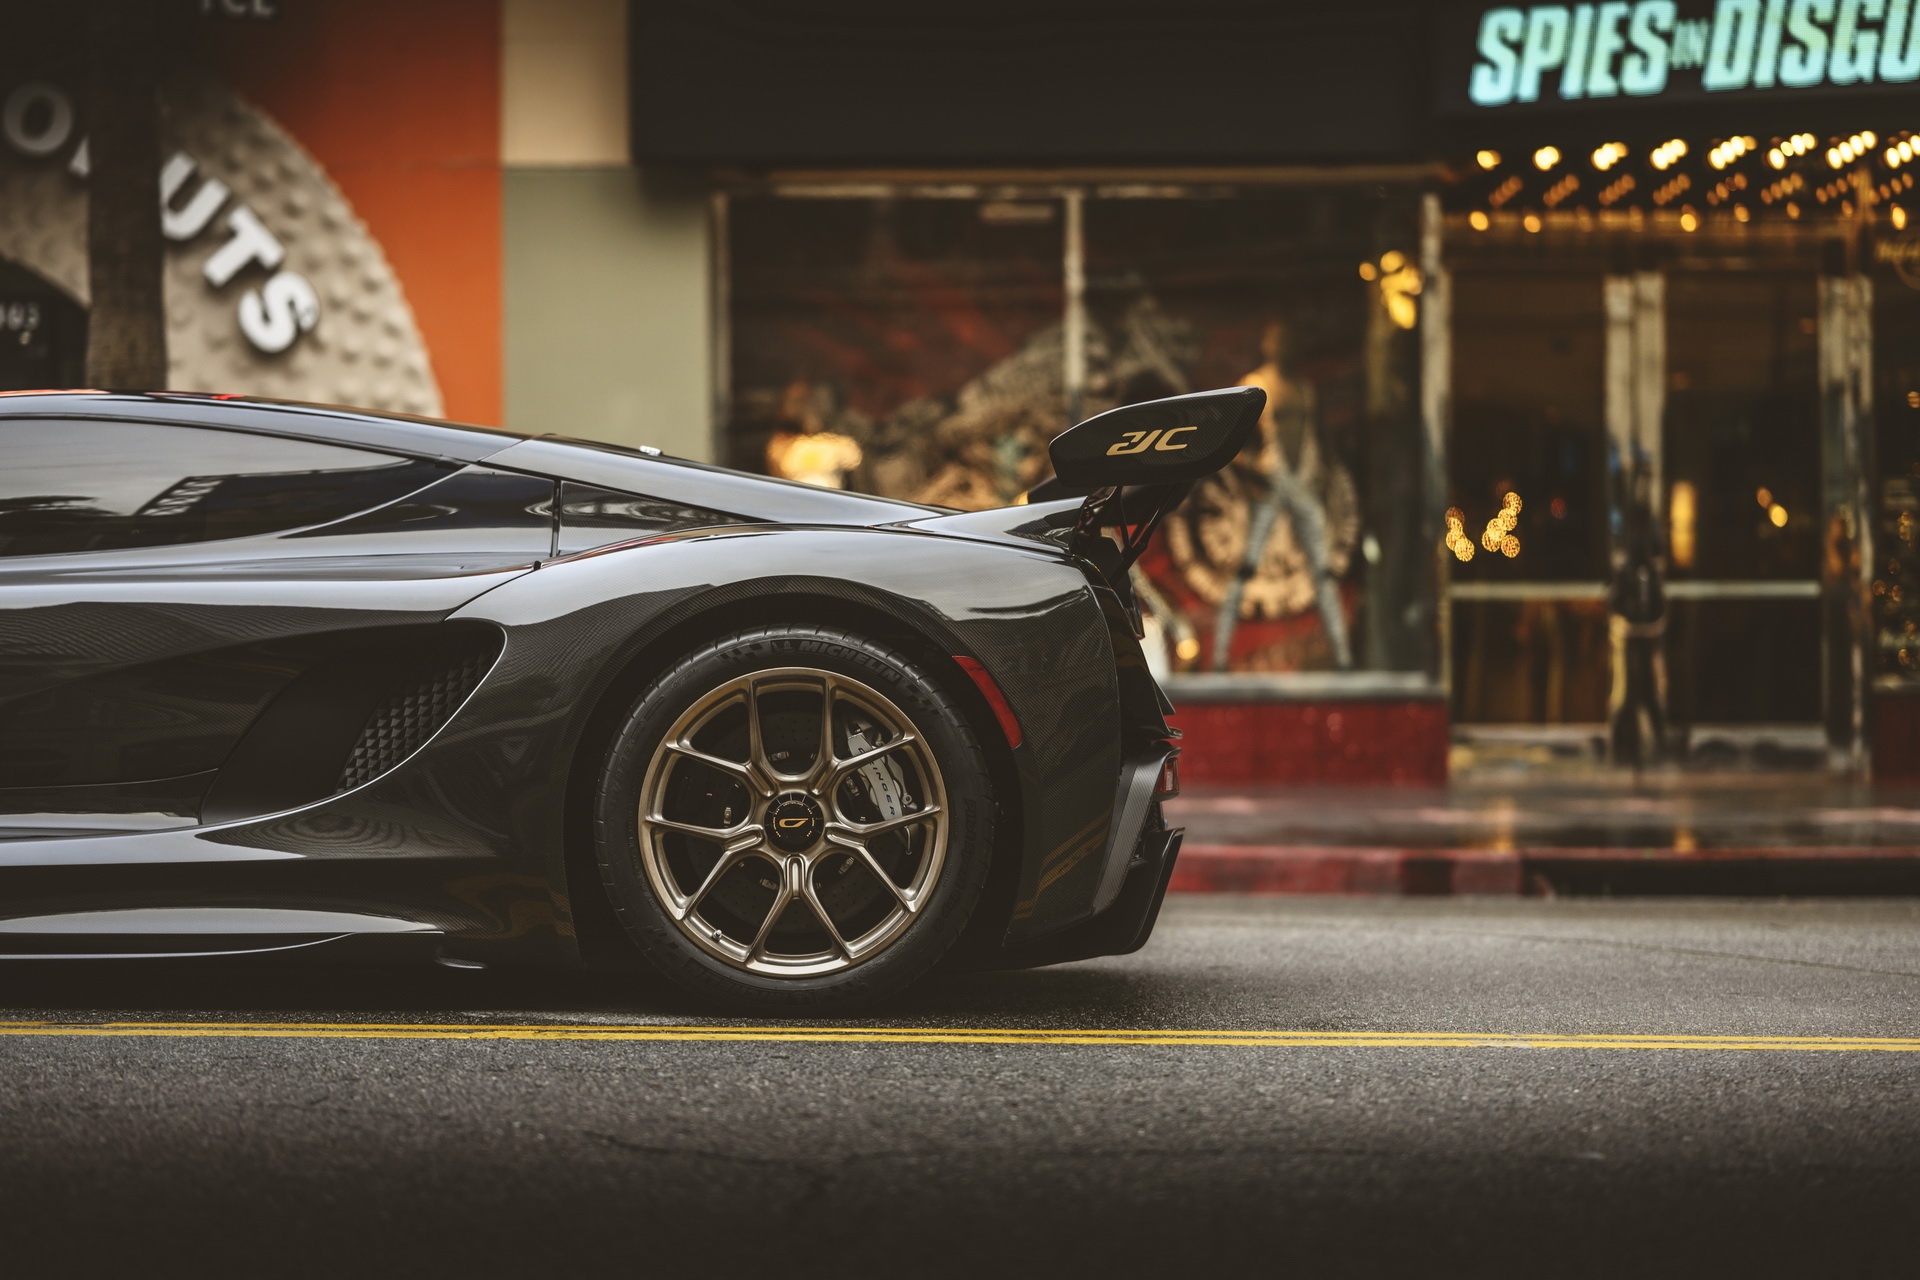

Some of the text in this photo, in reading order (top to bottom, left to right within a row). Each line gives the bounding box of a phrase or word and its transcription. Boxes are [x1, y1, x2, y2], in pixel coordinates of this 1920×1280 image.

[1468, 0, 1678, 106] SPIES
[1671, 18, 1709, 69] IN
[798, 640, 901, 684] MICHELIN
